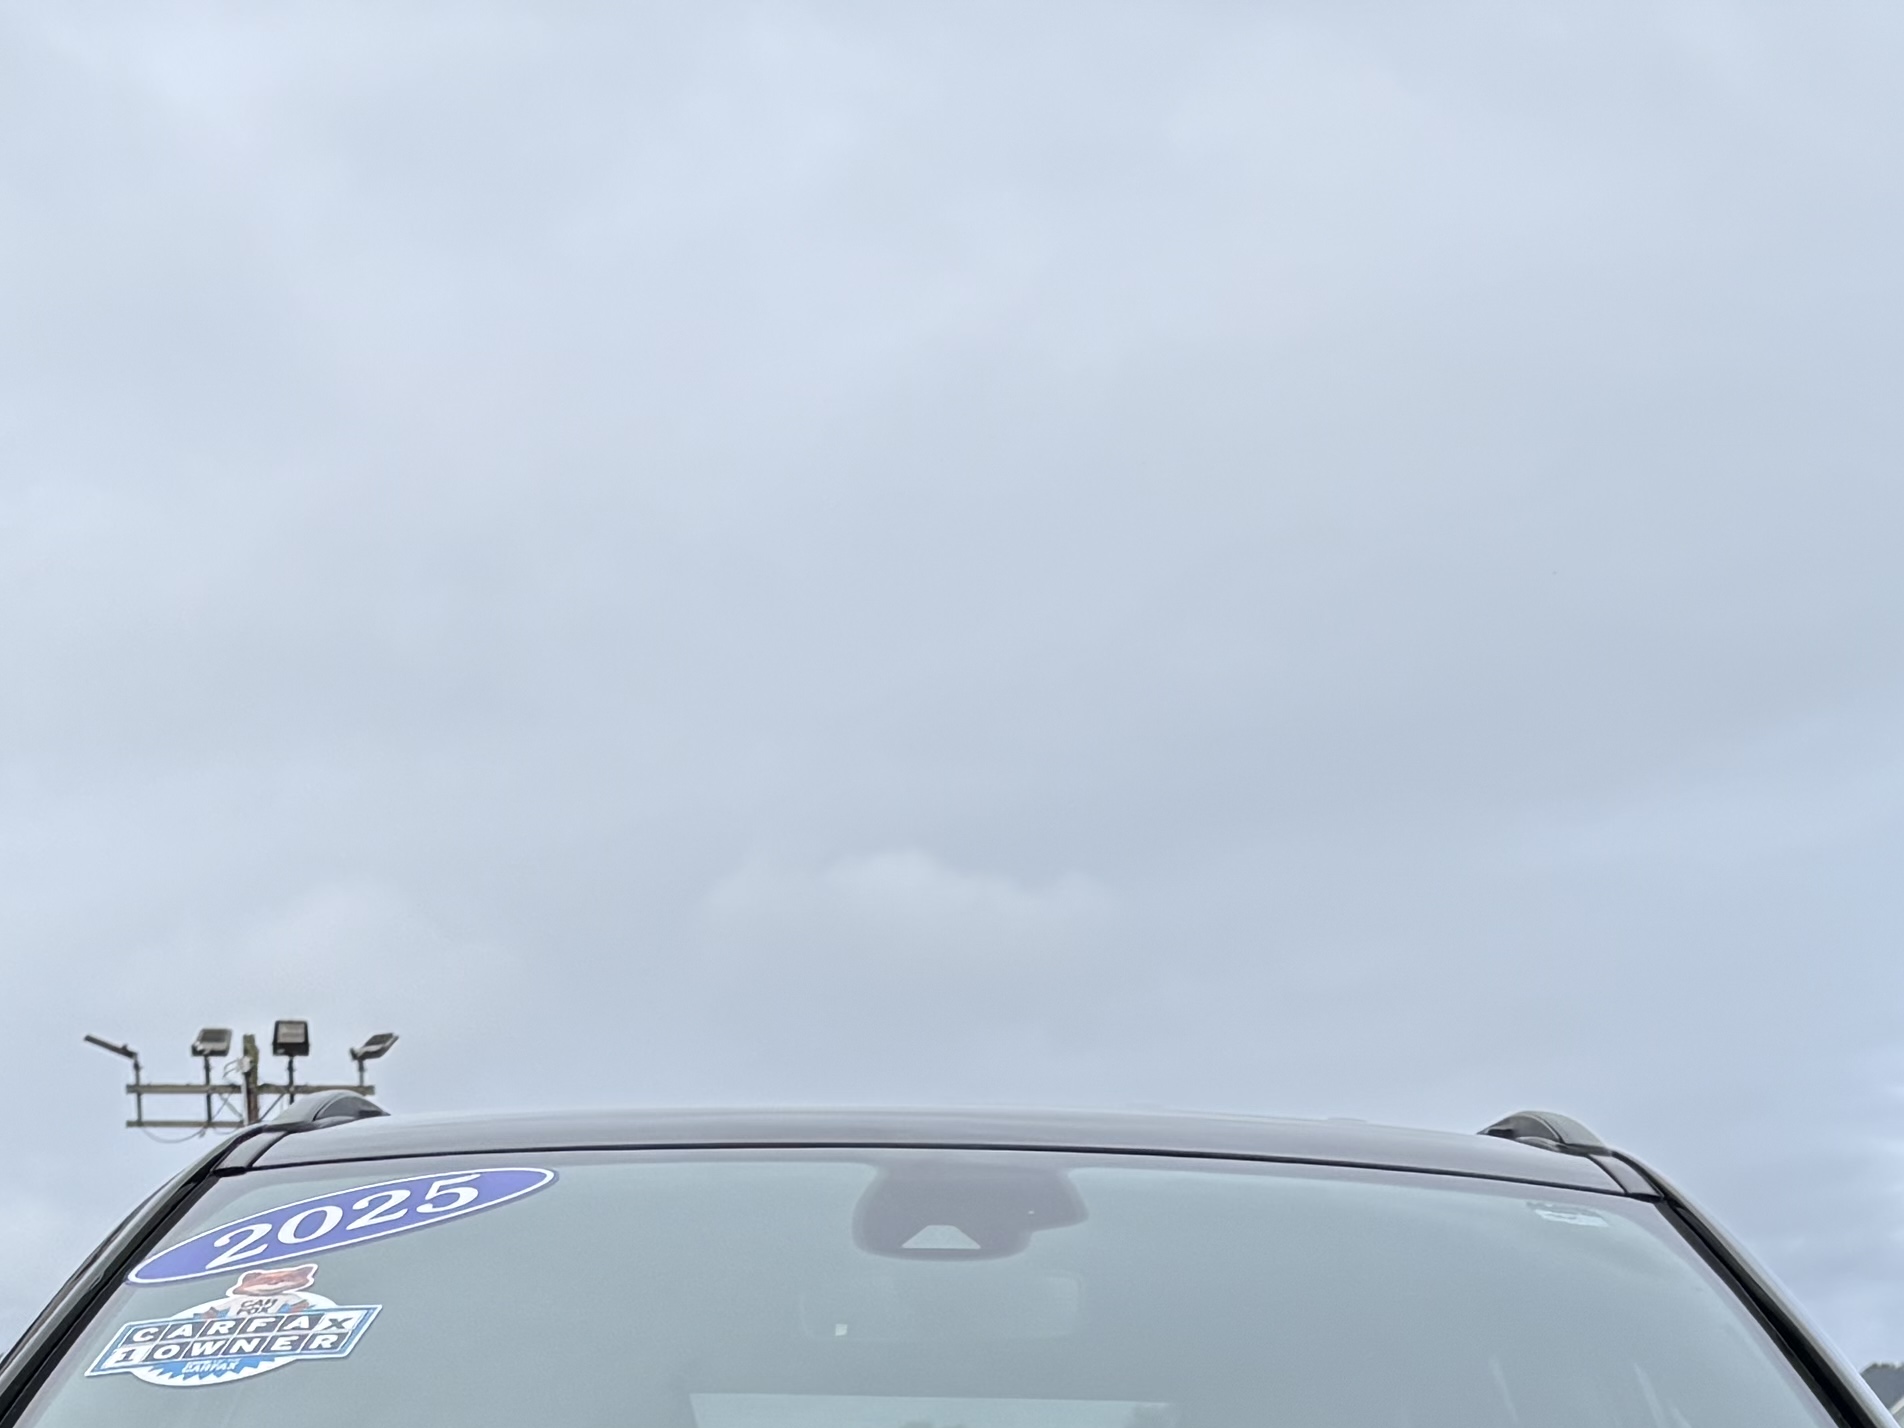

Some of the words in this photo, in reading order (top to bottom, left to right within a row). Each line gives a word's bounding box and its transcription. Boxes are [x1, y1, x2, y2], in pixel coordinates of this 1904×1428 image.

[205, 1174, 481, 1270] 2025
[132, 1315, 355, 1343] CARFAX
[115, 1348, 137, 1362] 1
[151, 1333, 341, 1360] OWNER
